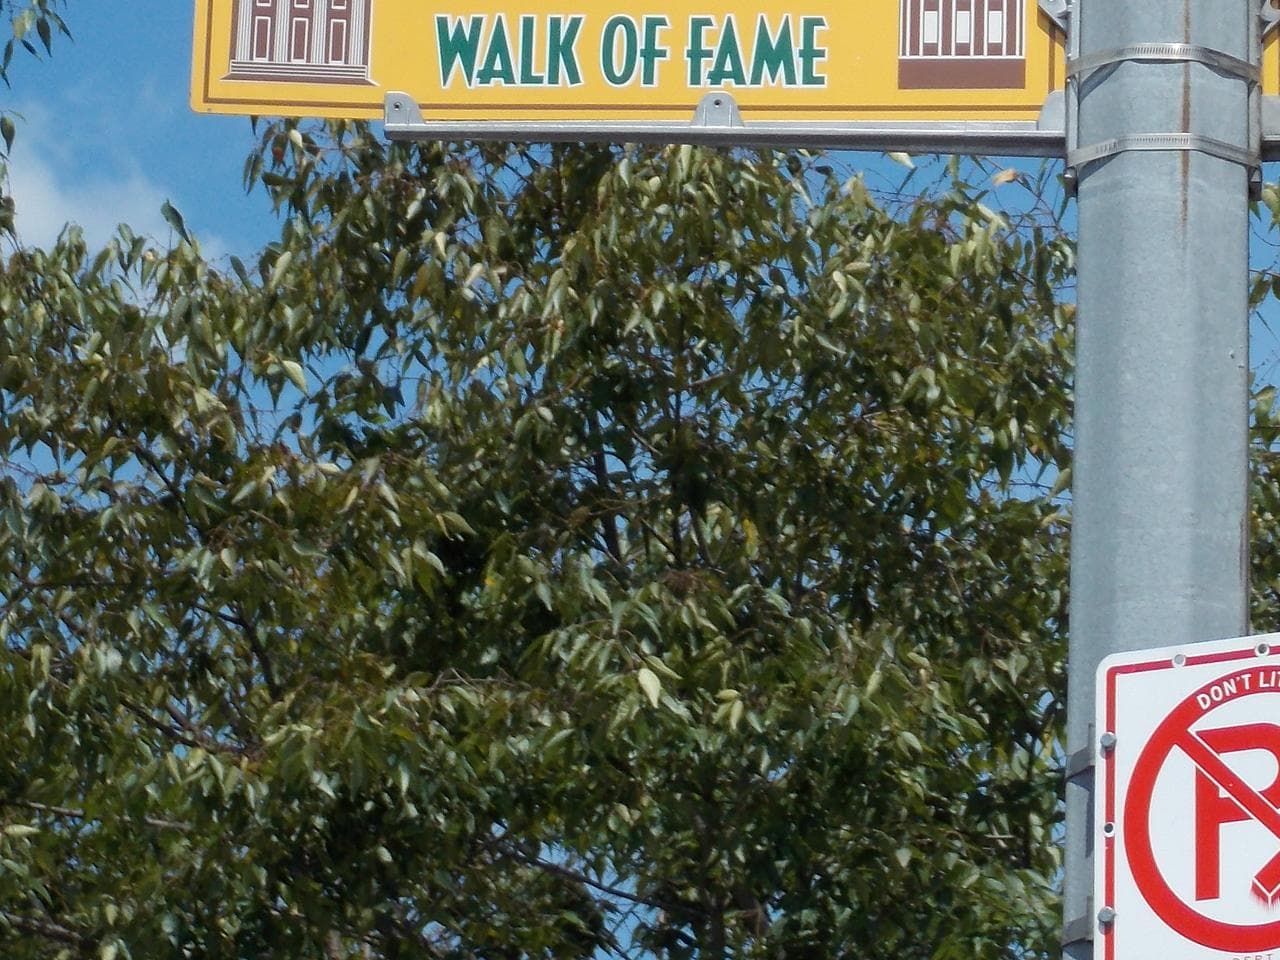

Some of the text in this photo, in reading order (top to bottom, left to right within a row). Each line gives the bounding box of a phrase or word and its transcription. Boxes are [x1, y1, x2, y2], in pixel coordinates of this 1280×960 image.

[434, 13, 830, 90] WALK OF FAME
[1195, 673, 1252, 710] DON'T
